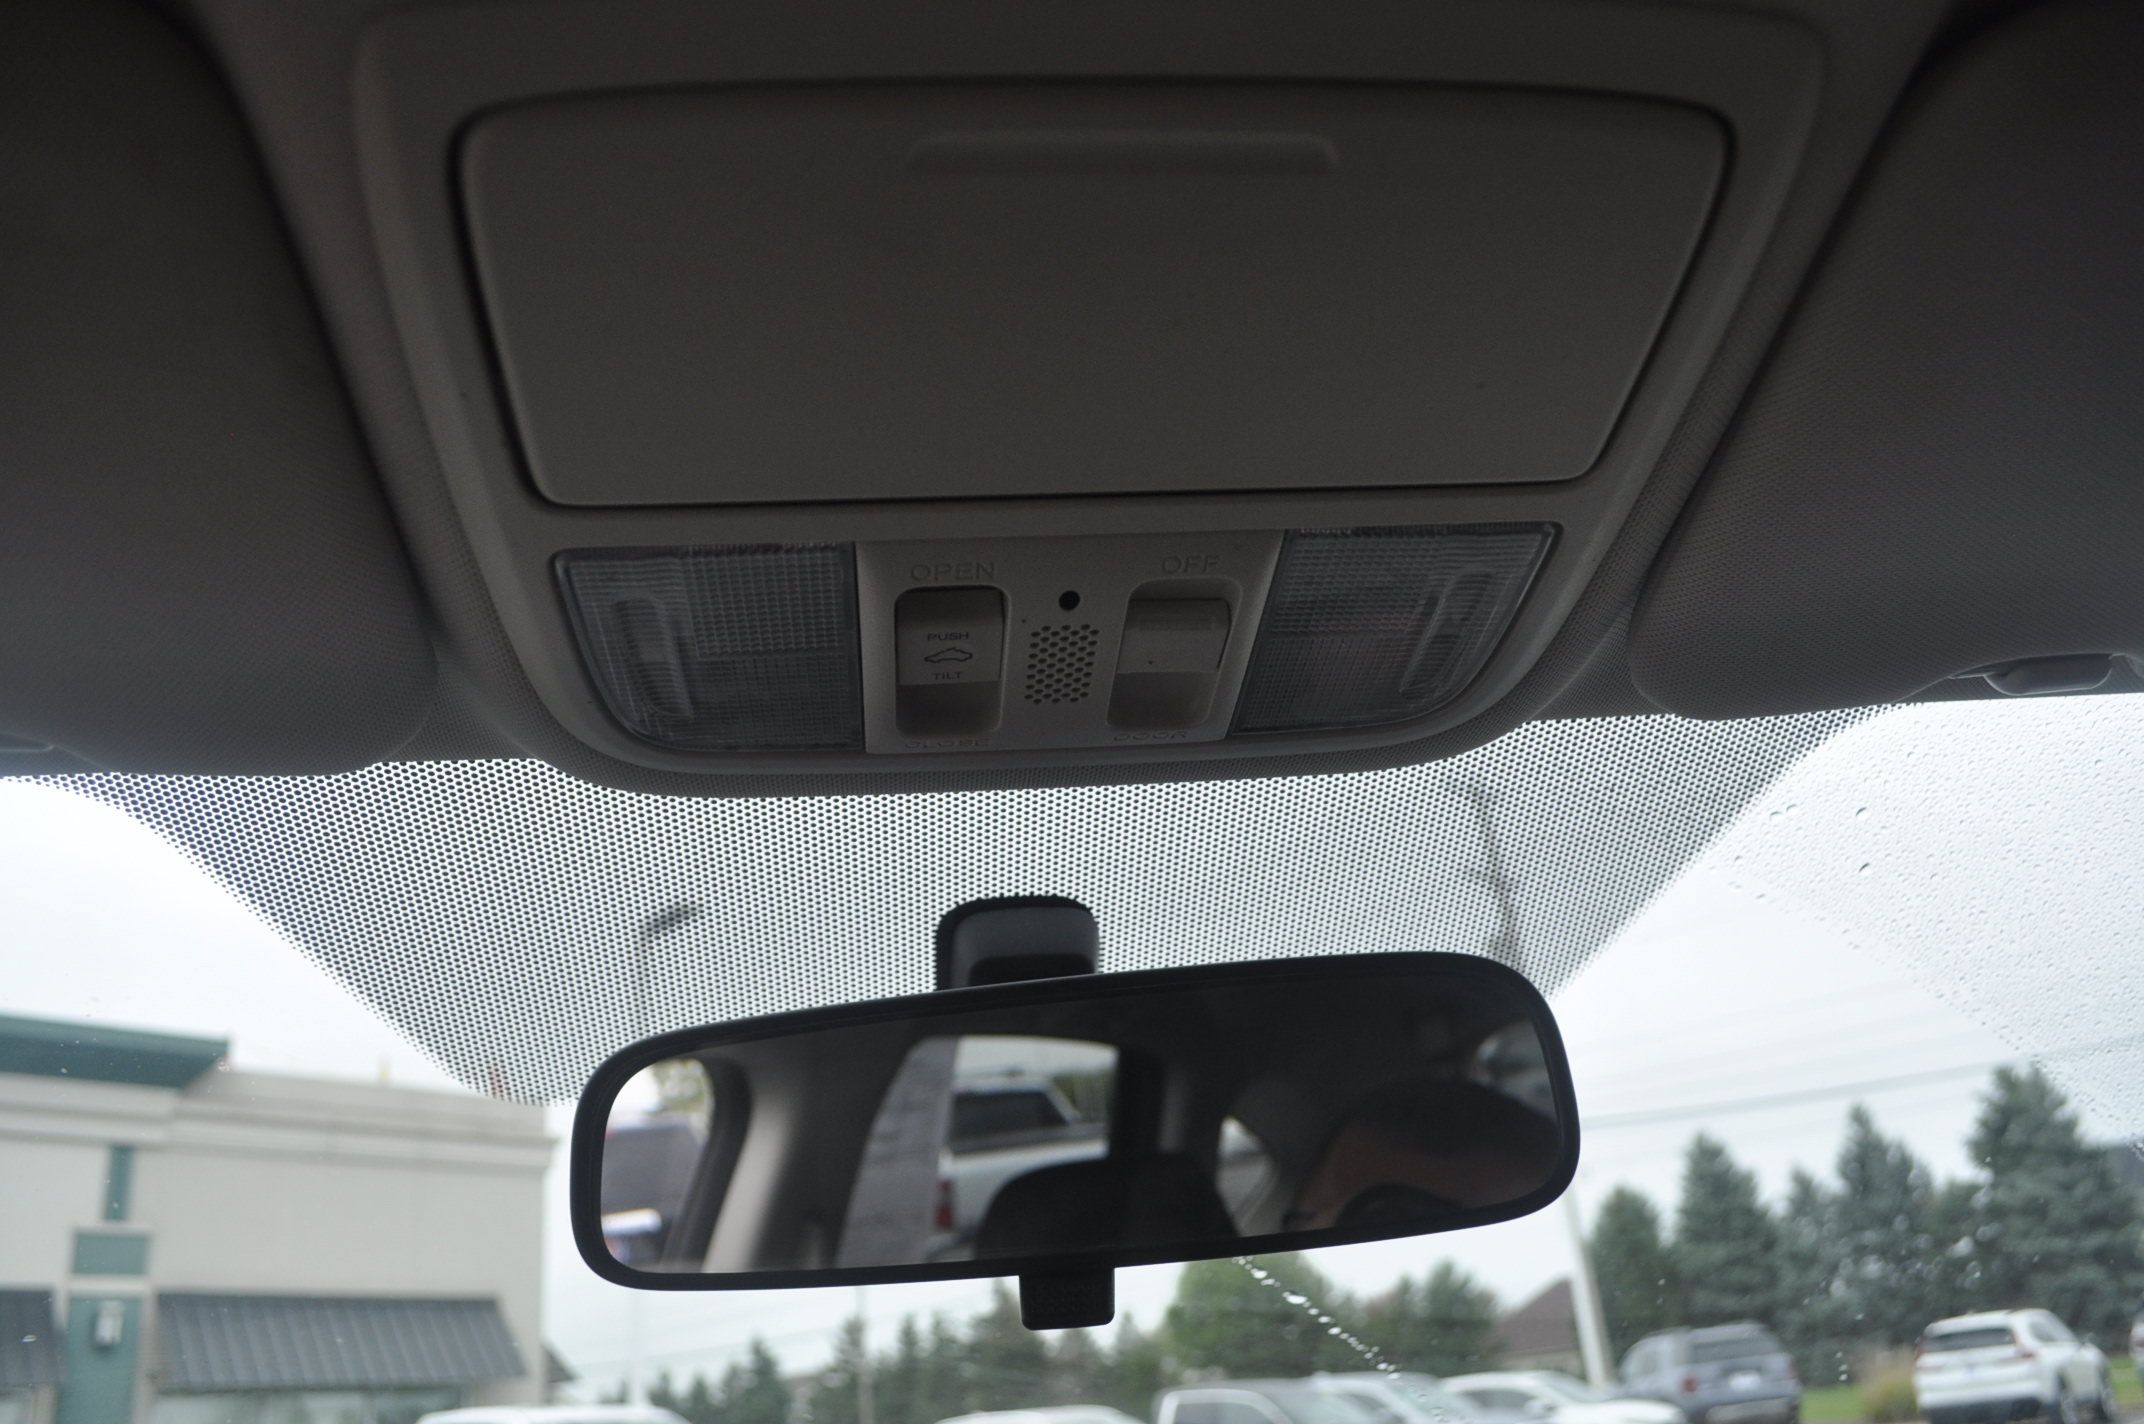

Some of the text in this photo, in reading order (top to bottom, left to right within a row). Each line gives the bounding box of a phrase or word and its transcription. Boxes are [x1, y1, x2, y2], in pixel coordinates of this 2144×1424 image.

[910, 561, 995, 582] OPEN
[1161, 554, 1220, 575] OFF
[926, 631, 970, 642] PUSH
[931, 670, 964, 681] TILT
